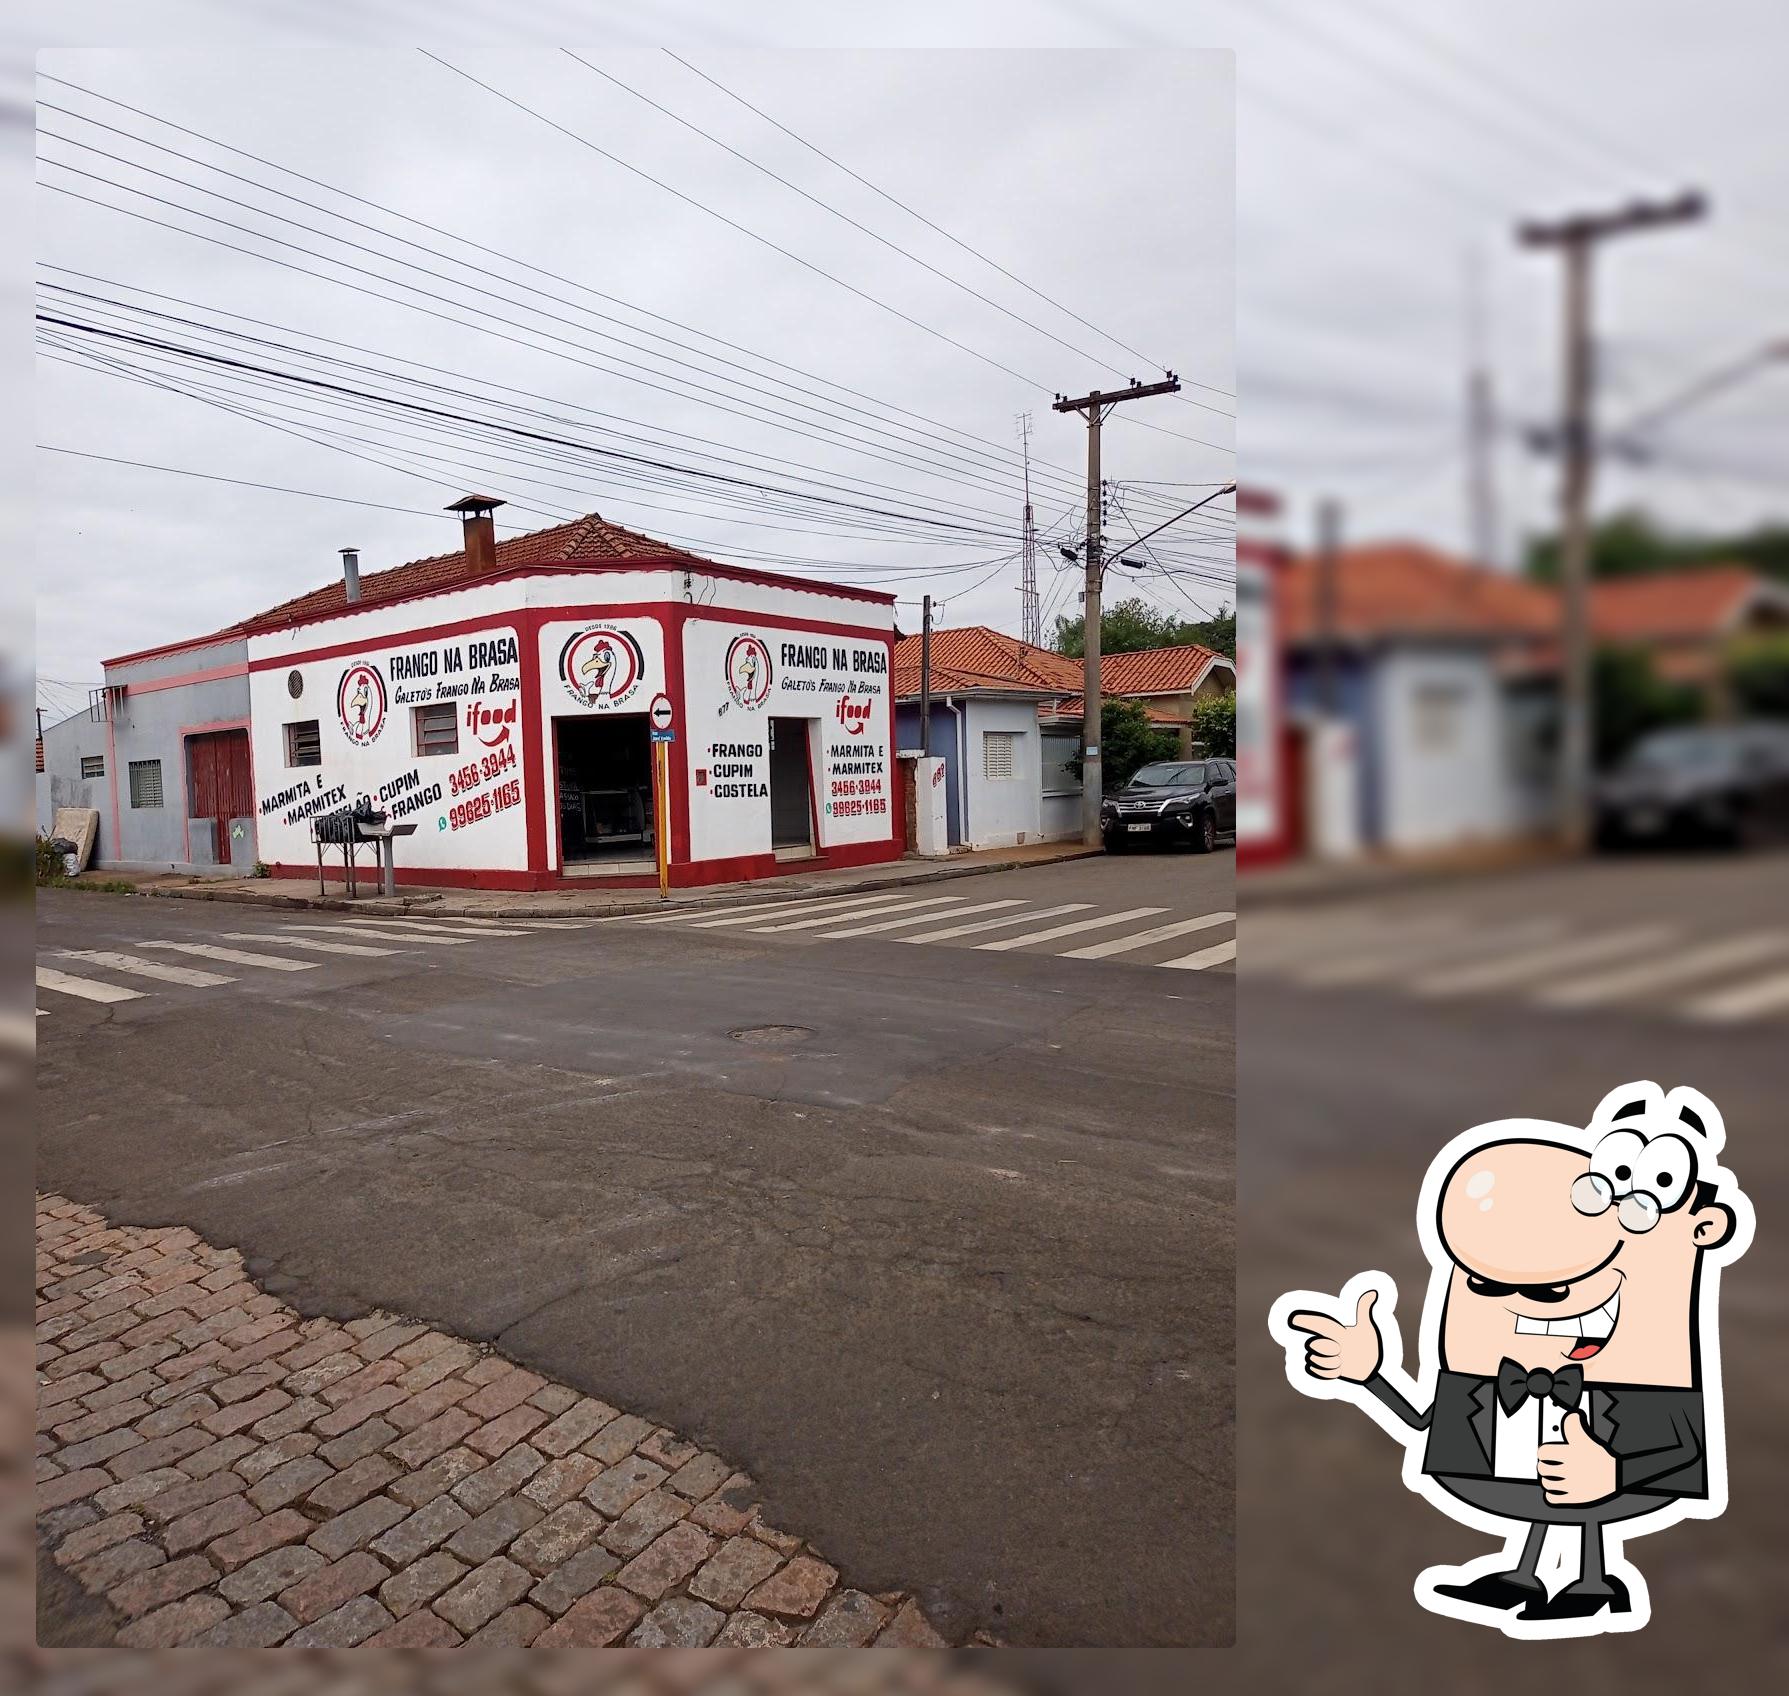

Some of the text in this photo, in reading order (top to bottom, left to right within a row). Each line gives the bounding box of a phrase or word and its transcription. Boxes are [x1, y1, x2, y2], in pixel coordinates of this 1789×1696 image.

[390, 637, 518, 681] FRANGO NA BRASA
[781, 643, 887, 674] FRANGO NA BRASA
[436, 682, 468, 699] FRANGO
[471, 675, 485, 695] NA
[489, 673, 520, 693] BRASA
[564, 684, 594, 709] FRANGO
[613, 684, 639, 708] BRASA
[819, 679, 846, 693] FRANGO
[848, 680, 857, 694] NA
[858, 681, 881, 695] BRASA
[466, 698, 517, 736] ifood
[836, 695, 872, 724] ifood
[712, 743, 763, 758] FRANGO
[830, 745, 884, 757] MARMITA E
[713, 764, 753, 778] CUPIM
[832, 762, 883, 775] MARMITEX
[262, 780, 311, 816] MARMITA
[316, 773, 323, 789] E
[380, 769, 420, 802] CUPIM
[714, 783, 769, 798] COSTELA
[287, 784, 347, 826] MARMITEX
[392, 783, 442, 820] FRANGO
